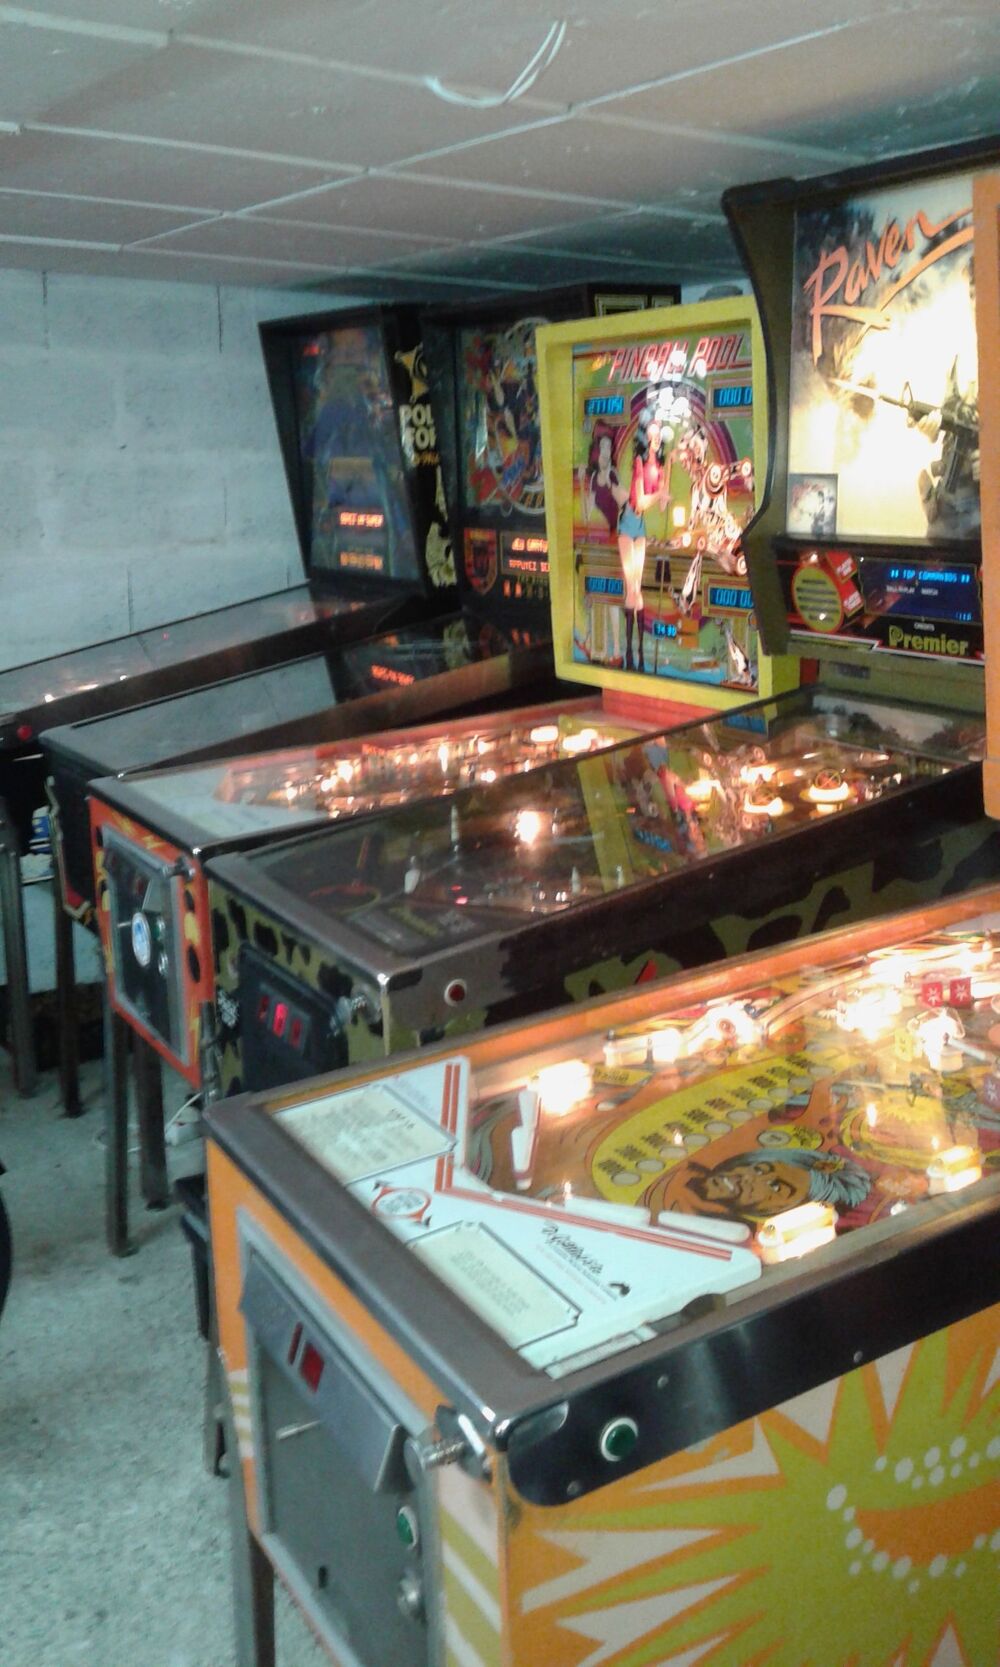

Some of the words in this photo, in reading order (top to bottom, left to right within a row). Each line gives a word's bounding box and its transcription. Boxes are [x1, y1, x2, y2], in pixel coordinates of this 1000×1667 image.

[803, 209, 975, 367] Raven
[607, 341, 689, 382] PINBALL
[687, 334, 750, 377] POOL
[888, 625, 969, 656] Premier
